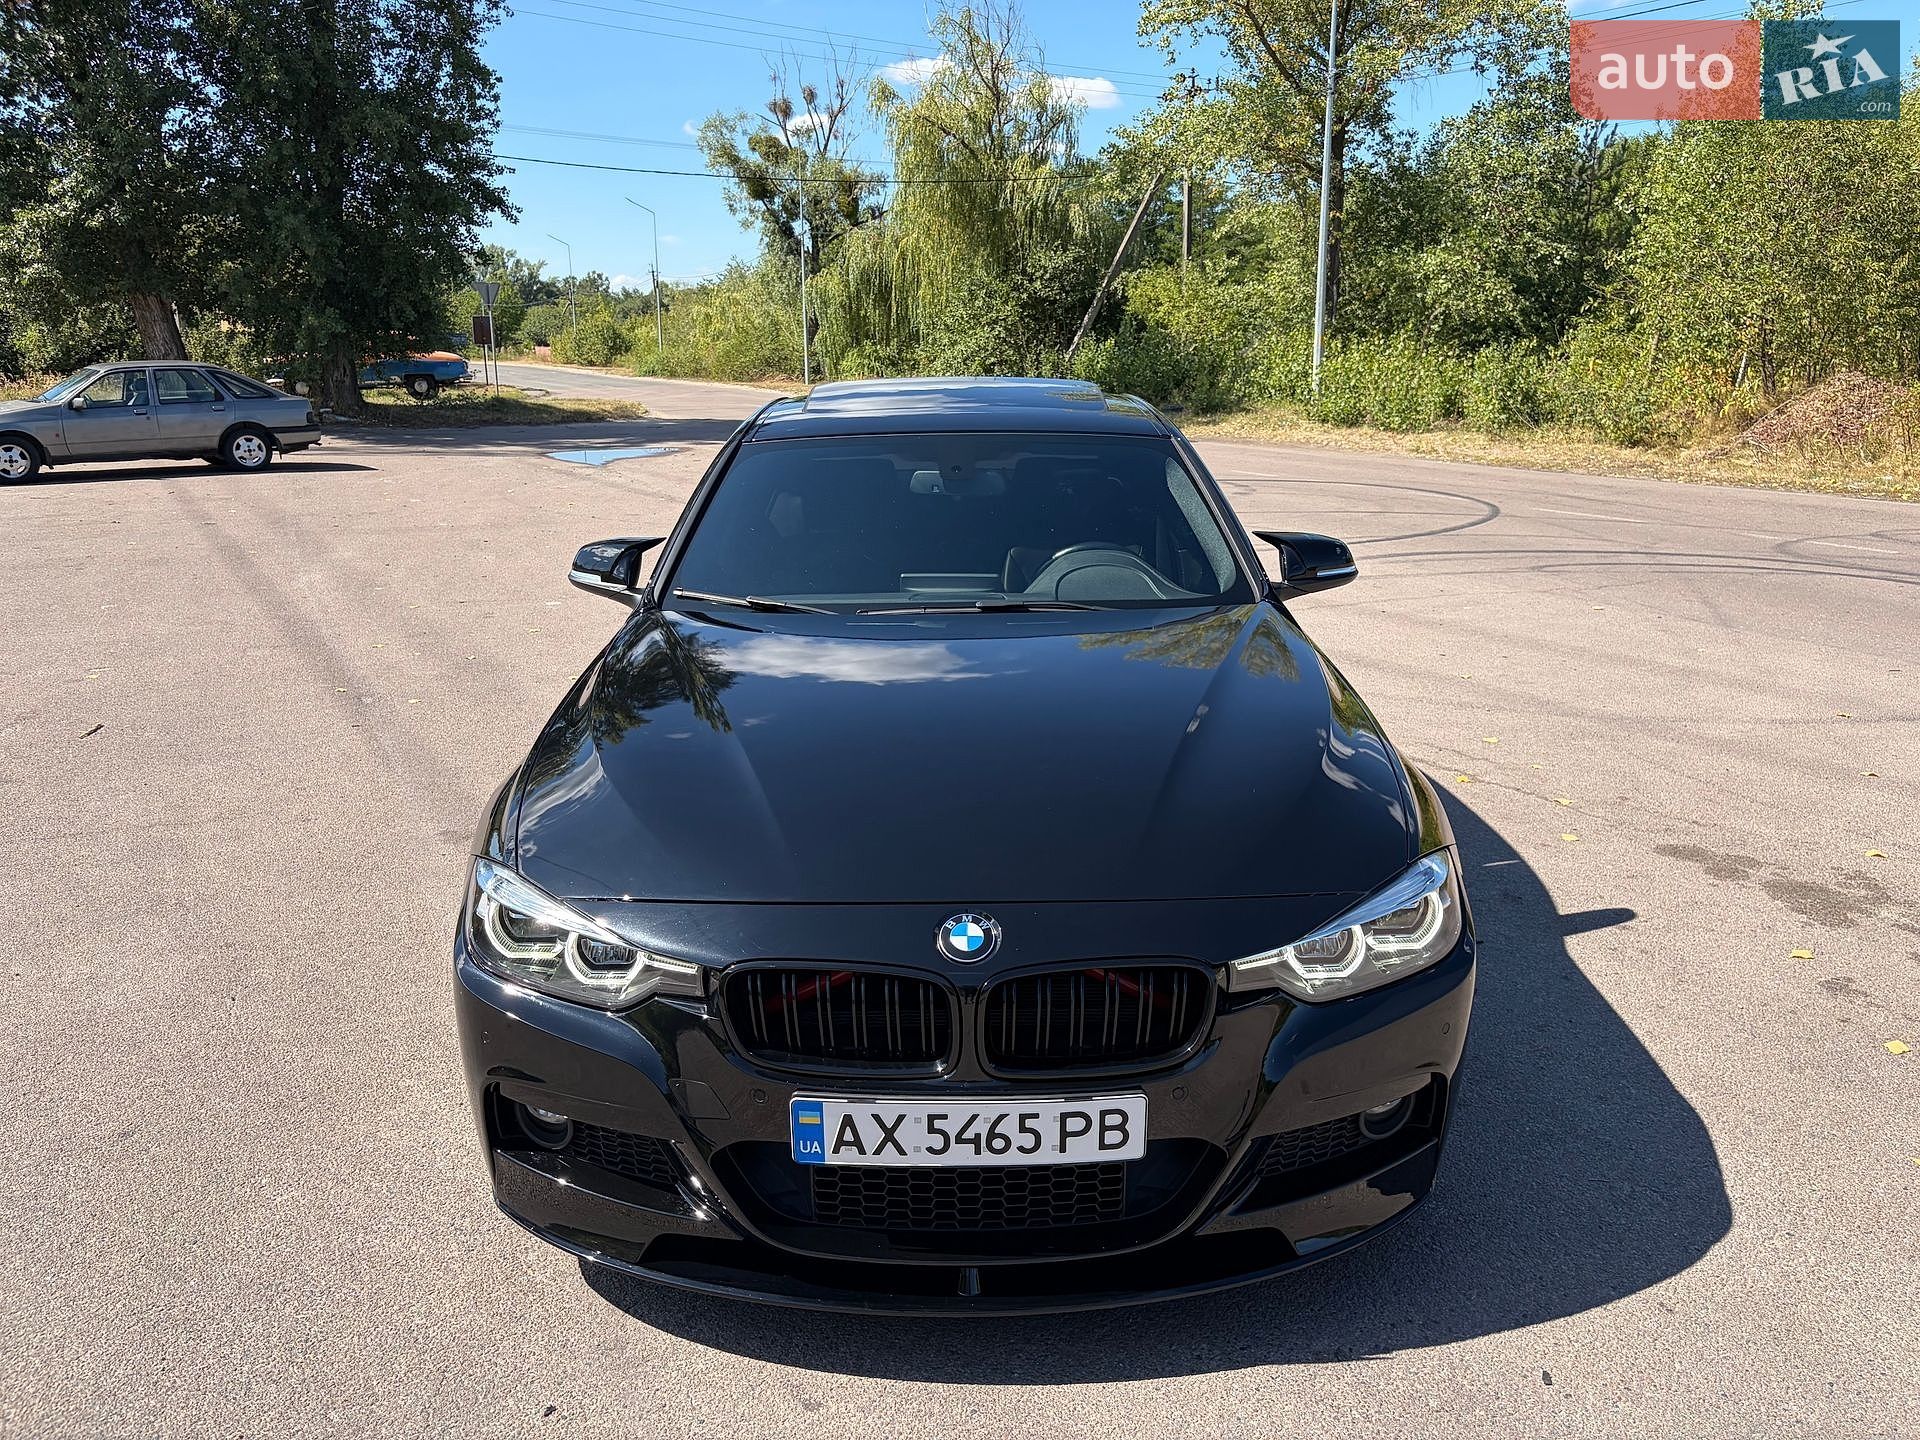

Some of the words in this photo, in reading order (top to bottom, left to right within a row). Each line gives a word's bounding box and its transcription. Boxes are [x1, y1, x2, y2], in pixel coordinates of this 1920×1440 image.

[946, 915, 990, 930] BMW
[831, 1113, 908, 1156] AX
[925, 1112, 1040, 1156] 5465
[1059, 1108, 1130, 1154] PB
[800, 1141, 822, 1155] UA
